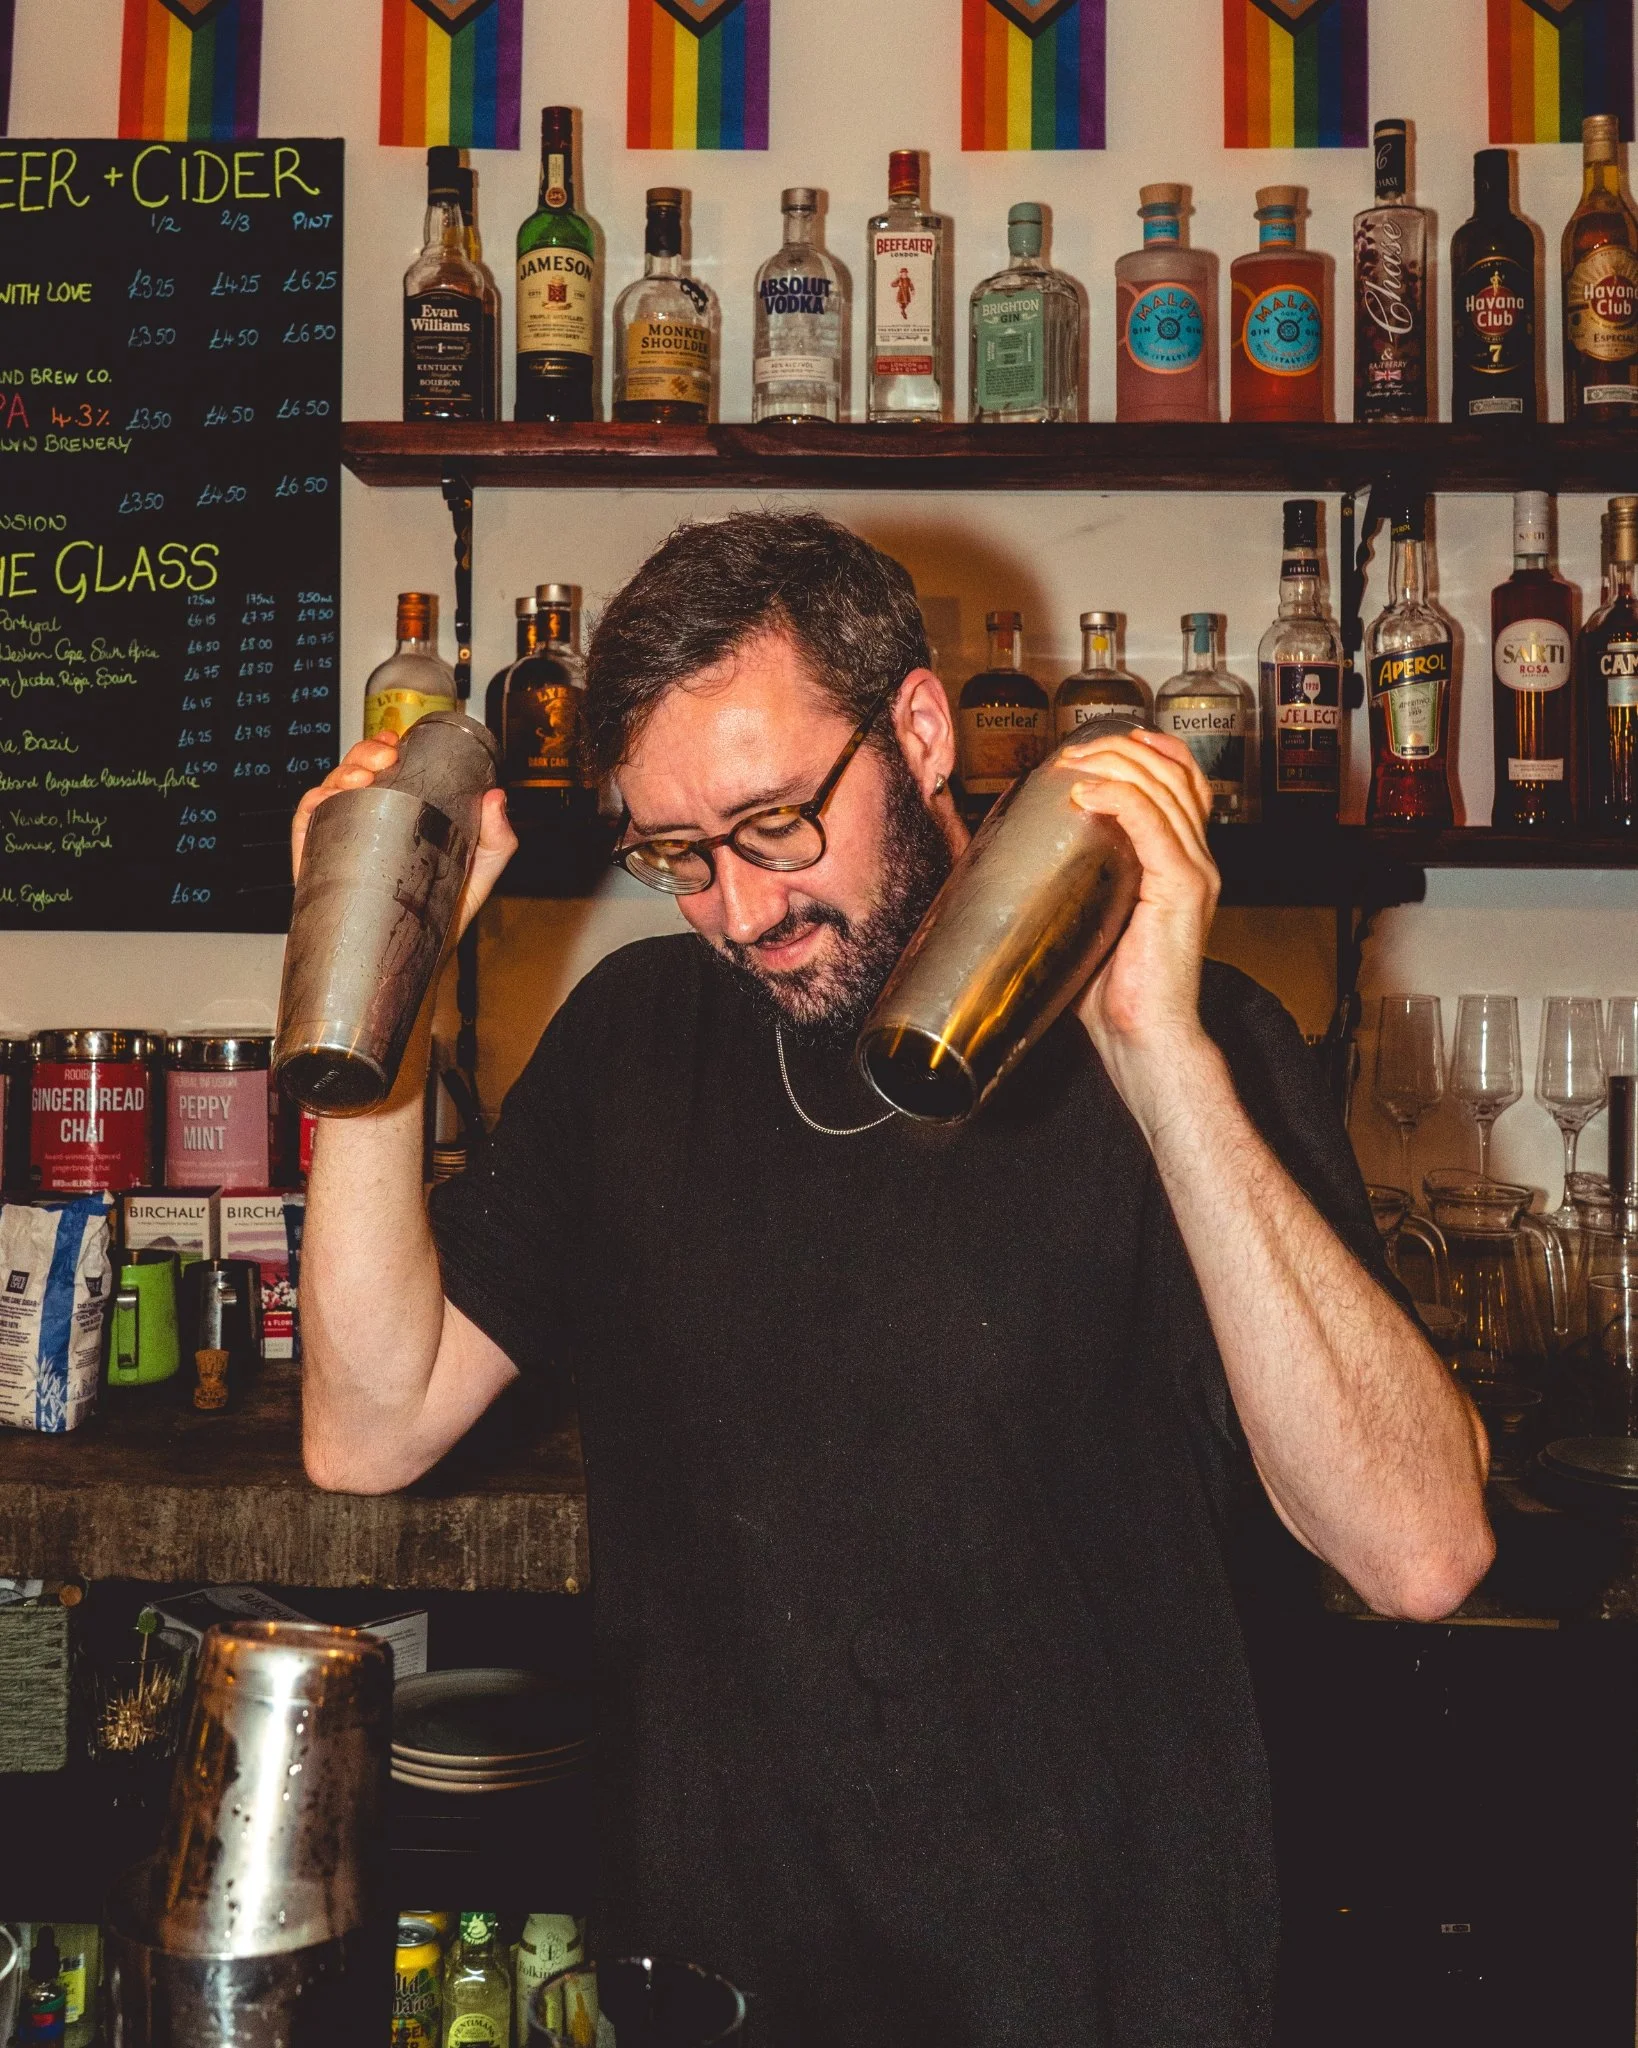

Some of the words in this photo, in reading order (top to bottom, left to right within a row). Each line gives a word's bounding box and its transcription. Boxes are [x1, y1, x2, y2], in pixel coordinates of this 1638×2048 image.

[132, 145, 320, 208] CIDER
[151, 213, 181, 233] 1/2
[220, 210, 250, 231] 2/3
[876, 238, 933, 255] BEEFEATER
[520, 256, 592, 282] JAMESON
[47, 282, 92, 302] LOVE
[760, 277, 833, 298] ABSOLUT
[421, 304, 459, 318] Evan
[764, 296, 825, 315] VODKA
[982, 299, 1040, 317] BRIGHTON
[1137, 293, 1199, 320] MALFY
[1255, 295, 1318, 322] MALFY
[1466, 295, 1524, 312] Havana
[1596, 299, 1632, 316] Club
[411, 318, 471, 332] Williams
[1000, 313, 1022, 324] GIN
[1477, 312, 1513, 327] Club
[649, 324, 706, 341] MONKEY
[1490, 345, 1502, 363] 7
[0, 369, 24, 385] ND
[30, 368, 79, 385] BREW
[86, 369, 112, 384] CO.
[420, 379, 460, 387] BOURBON
[55, 541, 219, 604] GLASS
[1503, 643, 1565, 665] SARTI
[1378, 654, 1446, 686] APEROL
[1519, 665, 1550, 674] ROSA
[1305, 682, 1320, 691] 1920
[976, 712, 1038, 729] Everleaf
[1173, 714, 1236, 731] Everleaf
[1280, 709, 1338, 725] SELECT
[64, 1069, 102, 1081] ROOIBS
[179, 1095, 232, 1120] PEPPY
[60, 1118, 104, 1143] CHAI
[183, 1126, 226, 1151] MINT
